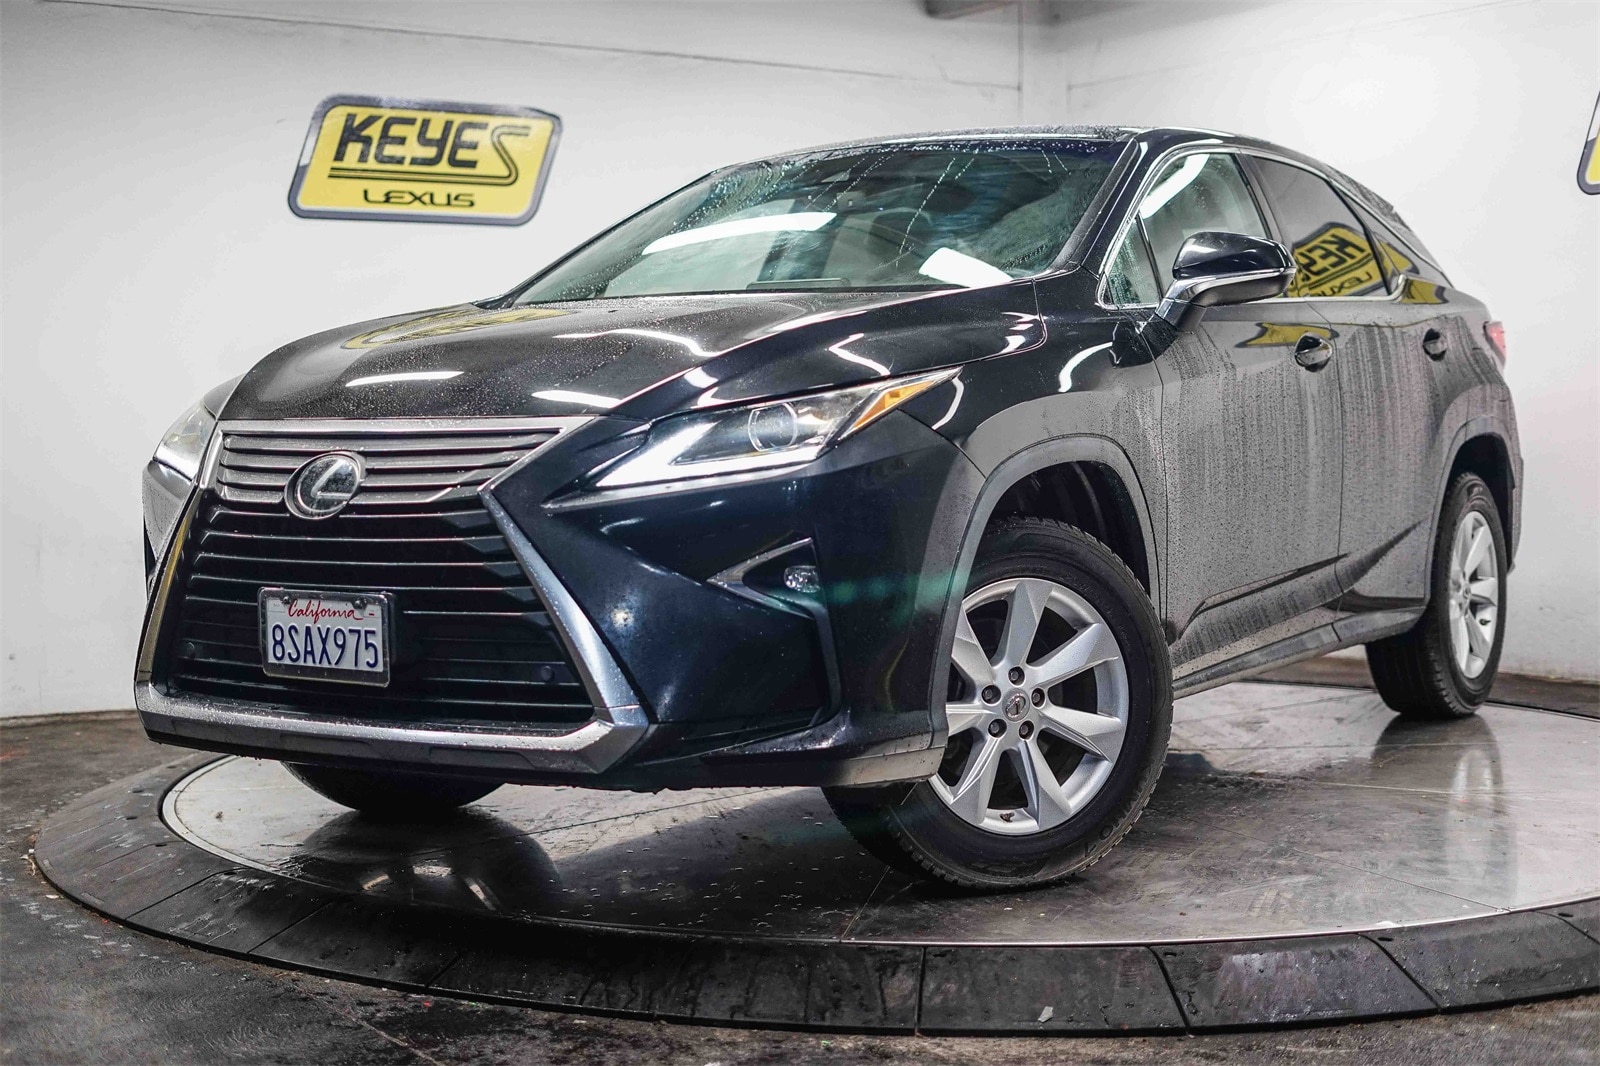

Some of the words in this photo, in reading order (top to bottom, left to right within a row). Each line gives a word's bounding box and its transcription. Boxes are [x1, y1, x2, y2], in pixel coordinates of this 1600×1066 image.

[333, 112, 531, 186] KEYES
[363, 189, 475, 208] LEXUS
[288, 599, 364, 624] California
[272, 623, 379, 668] 8SAX975
